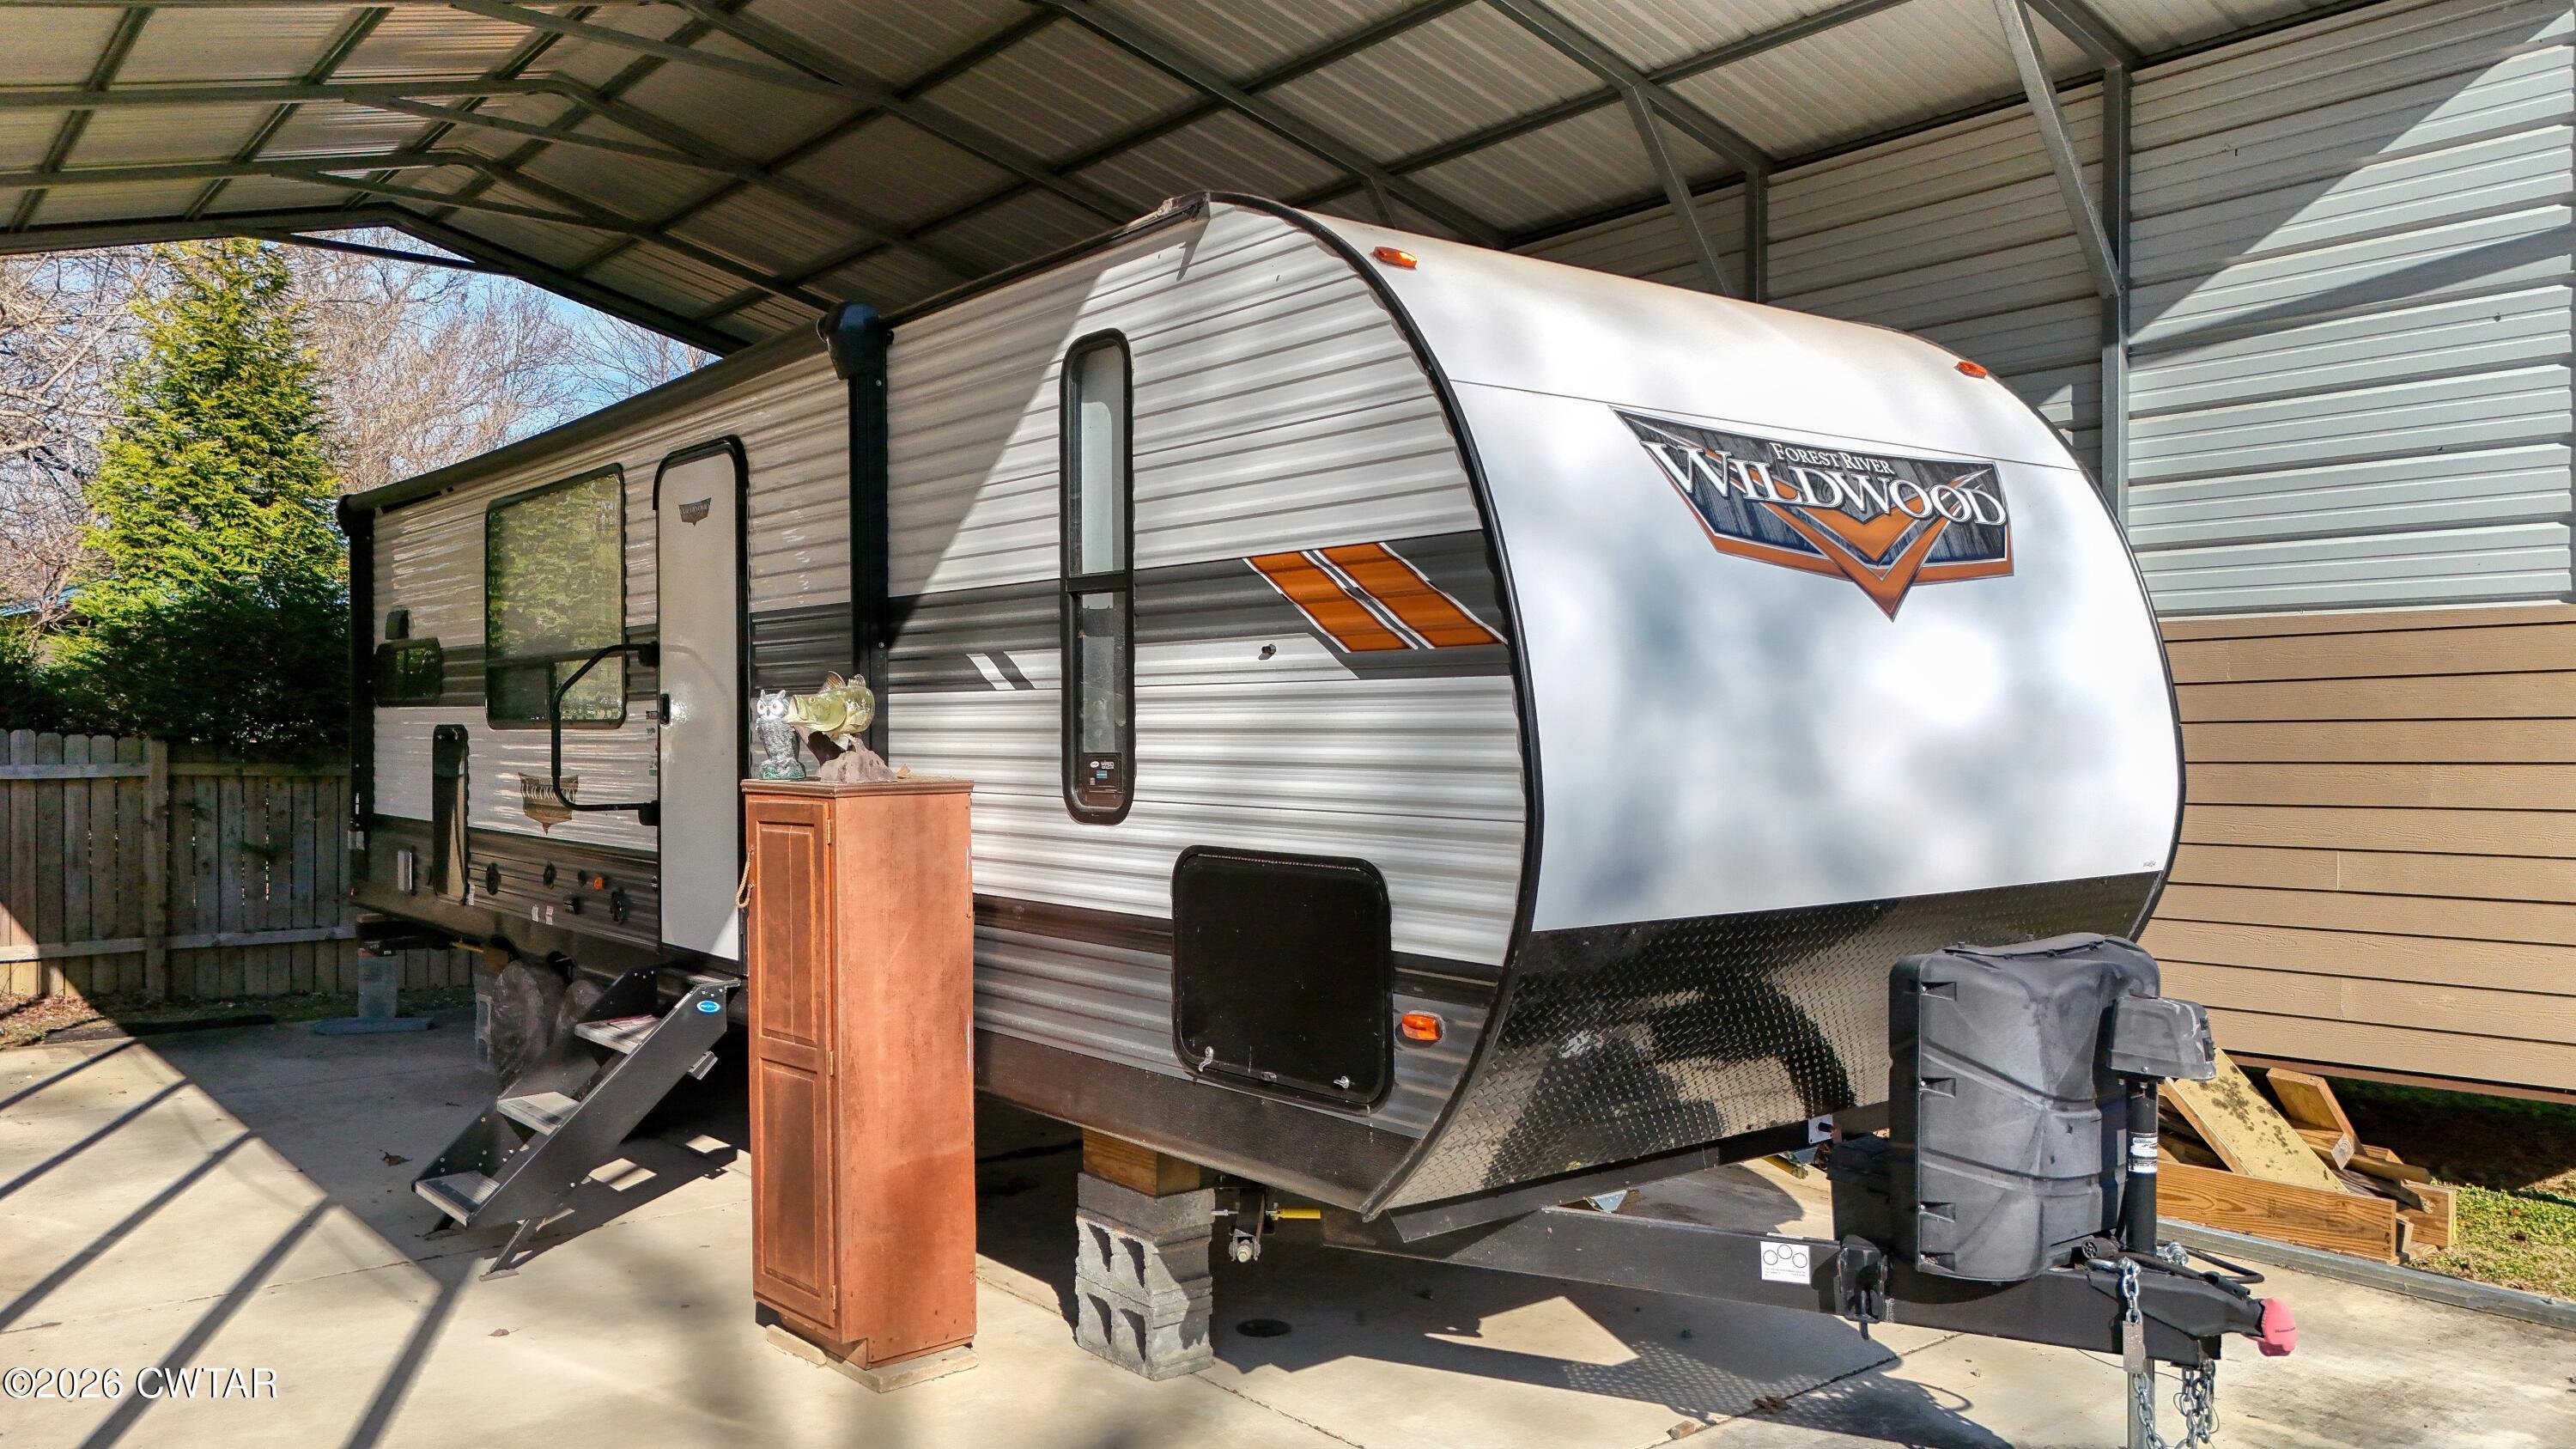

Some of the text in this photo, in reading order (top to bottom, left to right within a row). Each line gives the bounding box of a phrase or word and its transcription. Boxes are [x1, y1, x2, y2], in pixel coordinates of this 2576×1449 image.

[1639, 440, 2007, 527] WILDWOOD
[1769, 442, 1896, 474] FOREST RIVER
